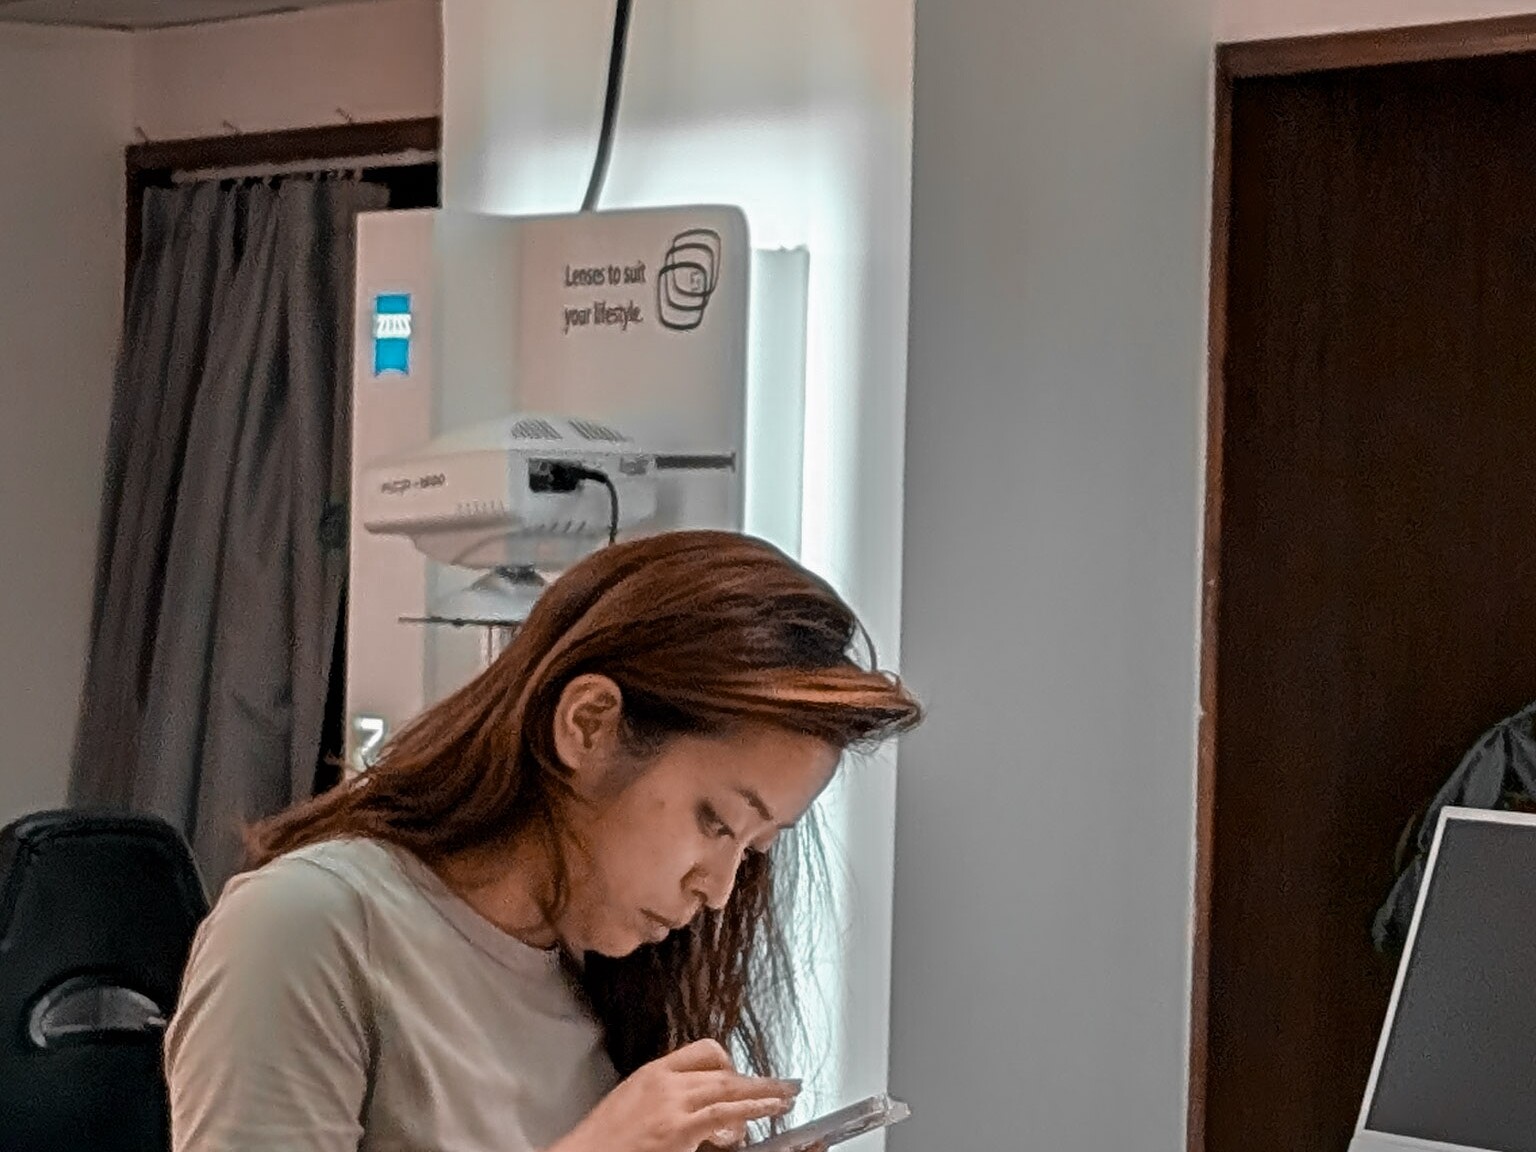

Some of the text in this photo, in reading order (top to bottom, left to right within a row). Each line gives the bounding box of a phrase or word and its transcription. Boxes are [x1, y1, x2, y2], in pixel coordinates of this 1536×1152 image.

[564, 260, 646, 287] Lenses to suit
[563, 307, 591, 335] your
